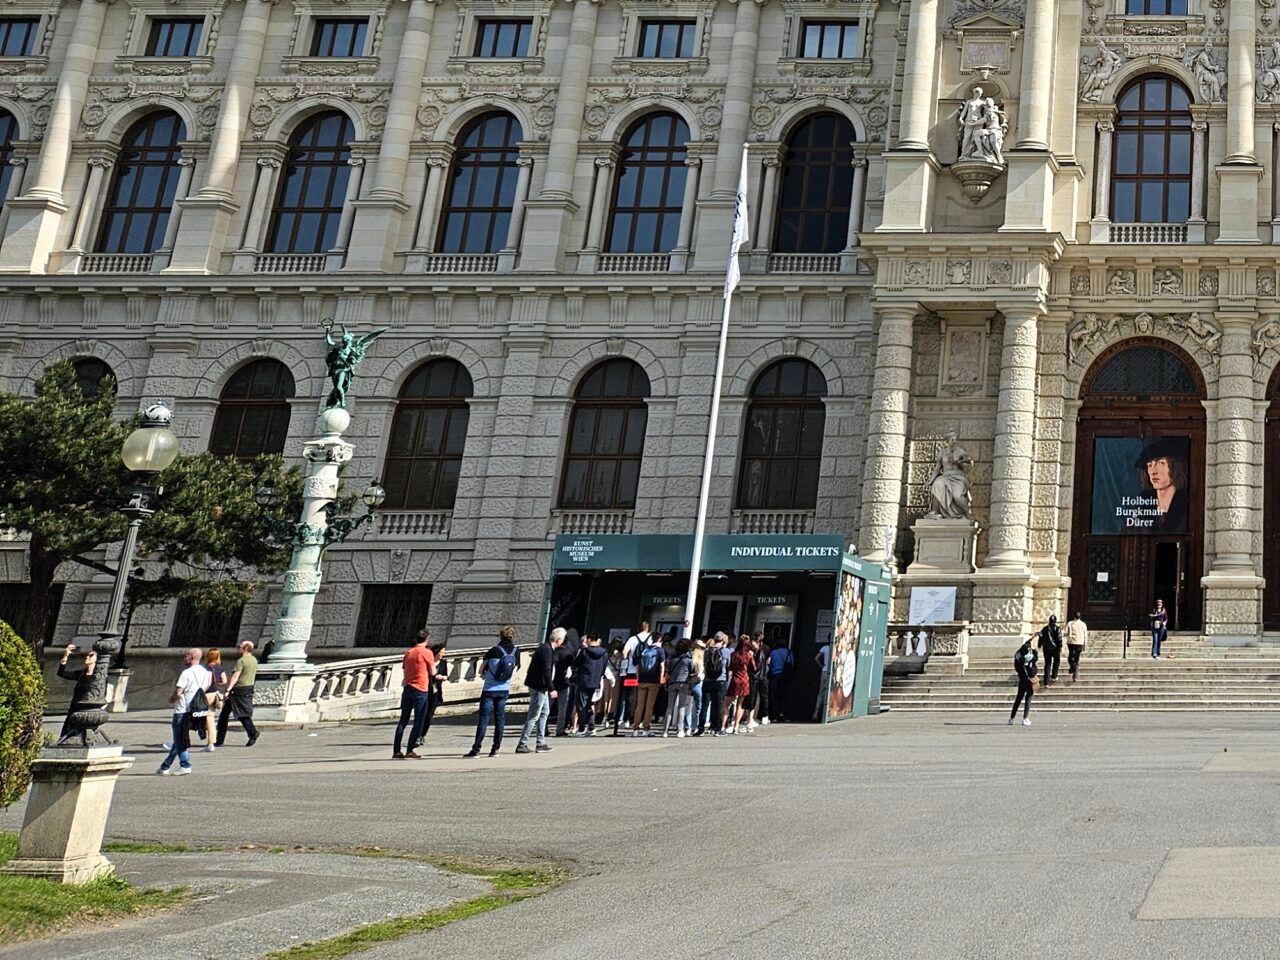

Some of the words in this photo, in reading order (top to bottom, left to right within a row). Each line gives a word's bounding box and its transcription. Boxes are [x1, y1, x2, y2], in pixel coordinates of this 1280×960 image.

[1121, 496, 1159, 506] Holbein
[1115, 506, 1164, 519] Burgkmair
[1126, 517, 1154, 527] Dürer
[731, 546, 794, 557] INDIVIDUAL
[795, 546, 840, 557] TICKETS
[653, 596, 682, 604] TICKETS
[757, 596, 787, 604] TICKETS
